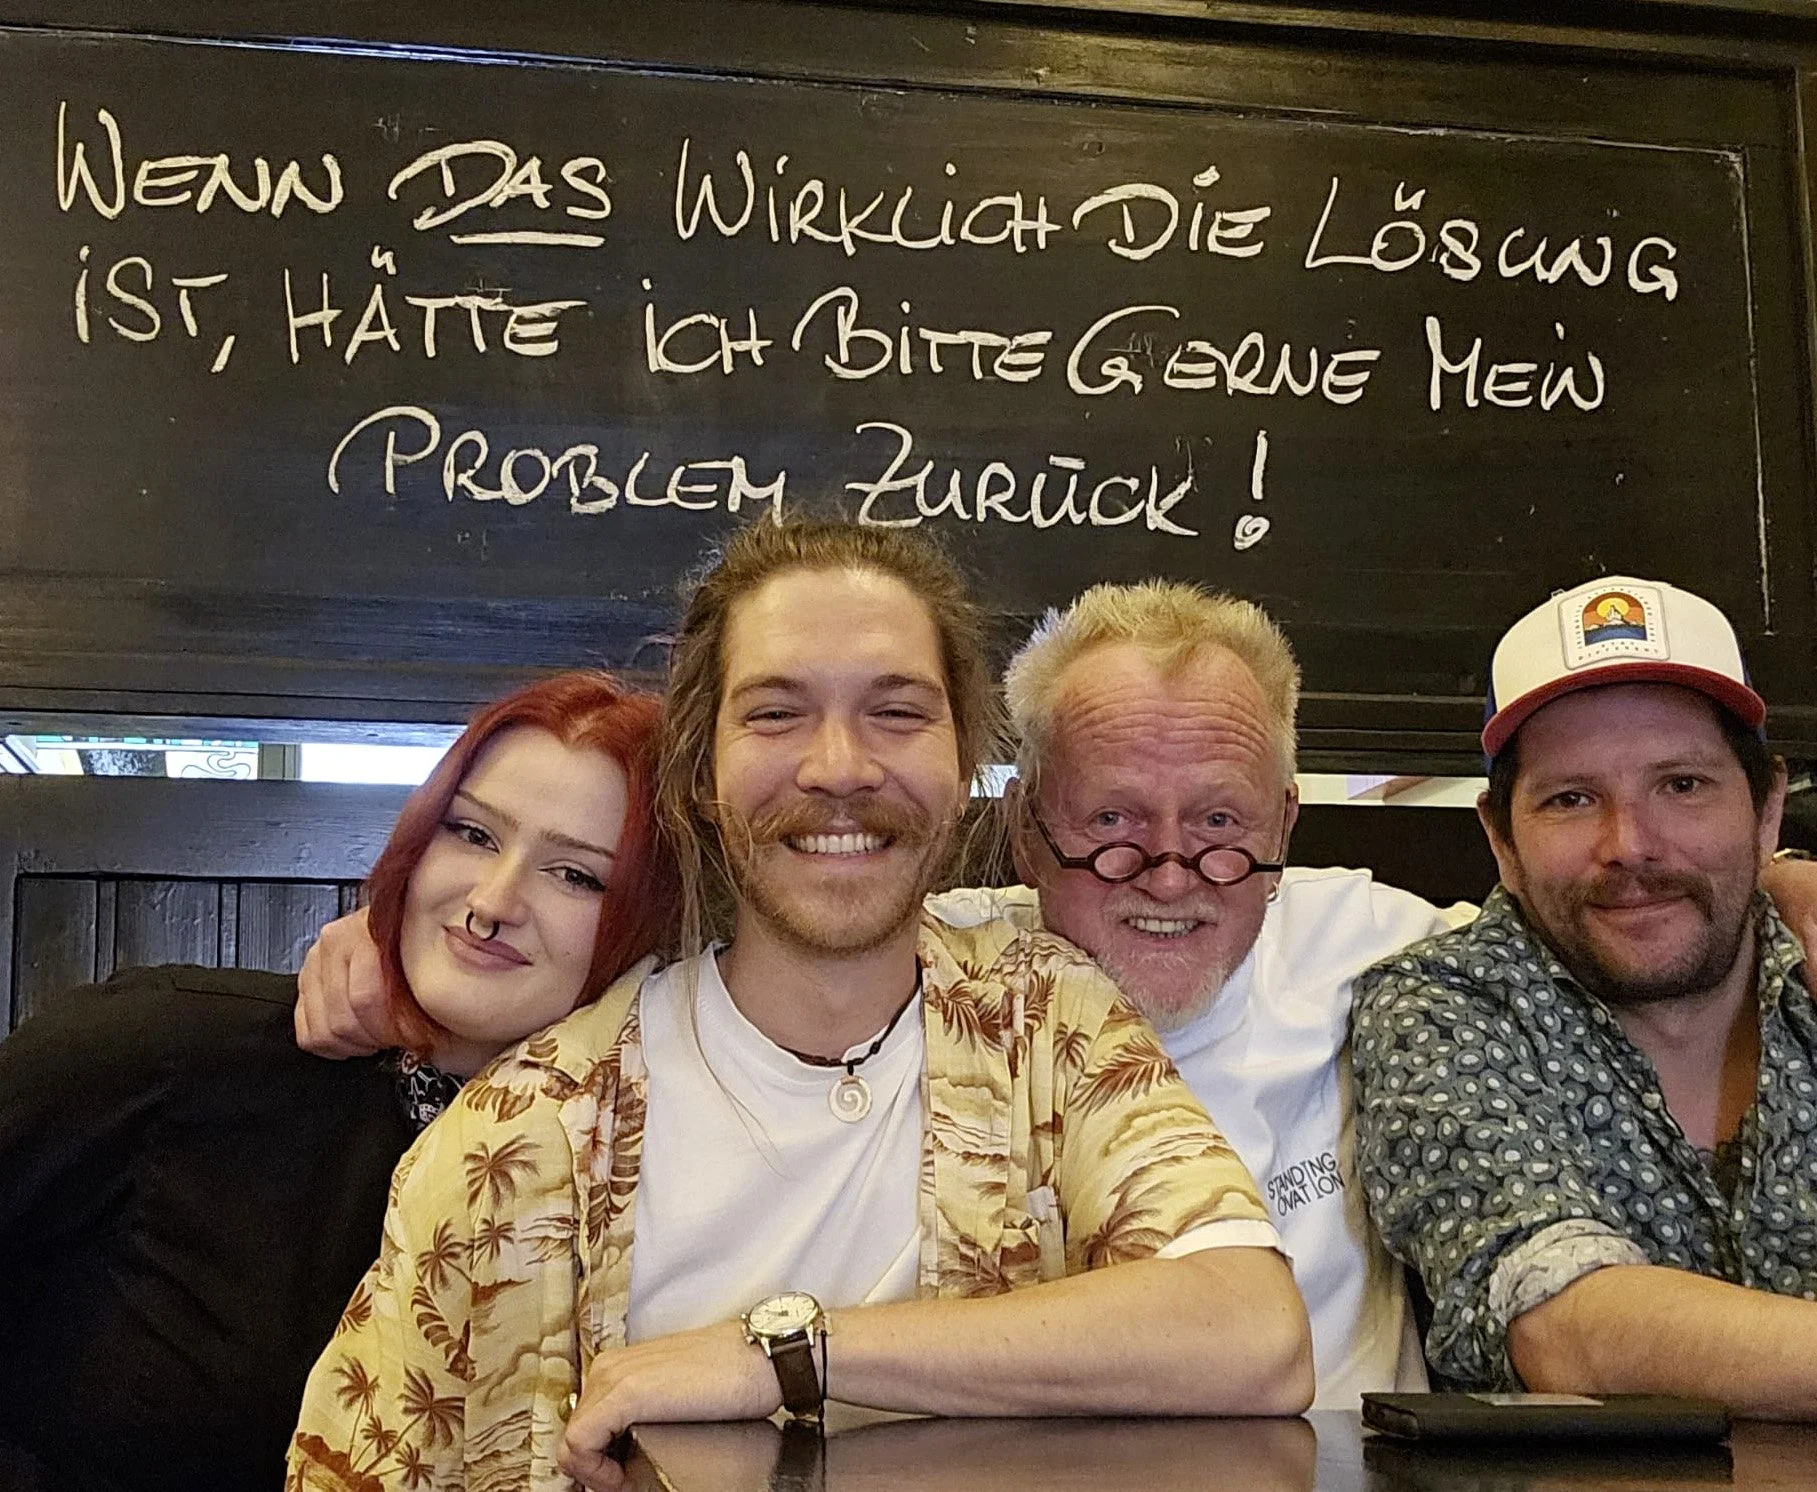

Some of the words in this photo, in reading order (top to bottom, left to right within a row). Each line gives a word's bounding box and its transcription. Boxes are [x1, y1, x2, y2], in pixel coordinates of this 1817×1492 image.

[57, 100, 344, 219] WENN
[387, 139, 612, 232] DAS
[284, 245, 588, 365] HÄTTE
[1065, 304, 1382, 405] GERNE
[327, 405, 788, 529] PROBLEM
[1267, 1152, 1337, 1200] STANDING
[1277, 1161, 1345, 1217] OVATION
